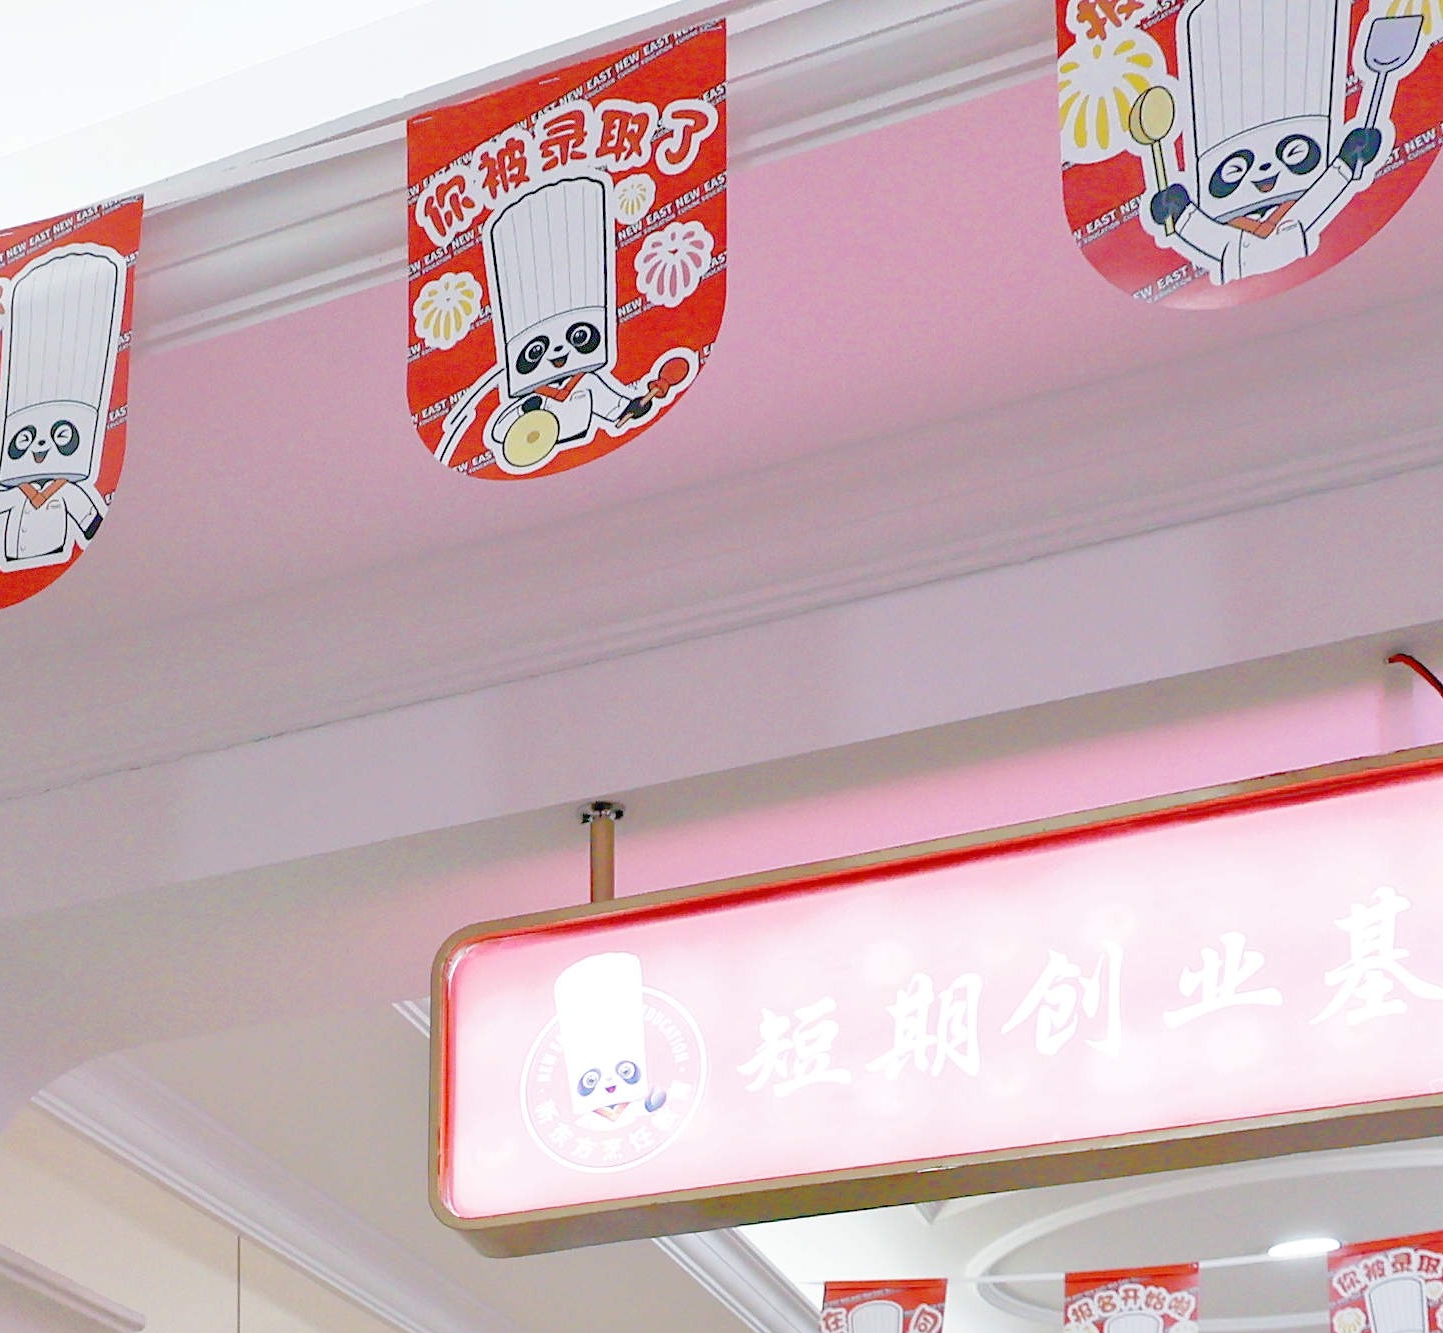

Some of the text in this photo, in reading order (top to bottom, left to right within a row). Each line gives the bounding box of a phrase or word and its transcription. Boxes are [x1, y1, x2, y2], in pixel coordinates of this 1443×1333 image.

[586, 68, 613, 90] EAST
[615, 51, 640, 73] NEW
[643, 33, 672, 56] EAST
[1401, 128, 1437, 154] NEW
[425, 110, 709, 237] 你被录取了
[617, 221, 643, 241] NEW
[646, 203, 673, 225] EAST
[675, 187, 700, 209] NEW
[1086, 210, 1117, 233] EAST
[6, 242, 27, 262] NEW
[29, 228, 51, 246] EAST
[53, 217, 74, 235] NEW
[1156, 263, 1189, 290] EAST
